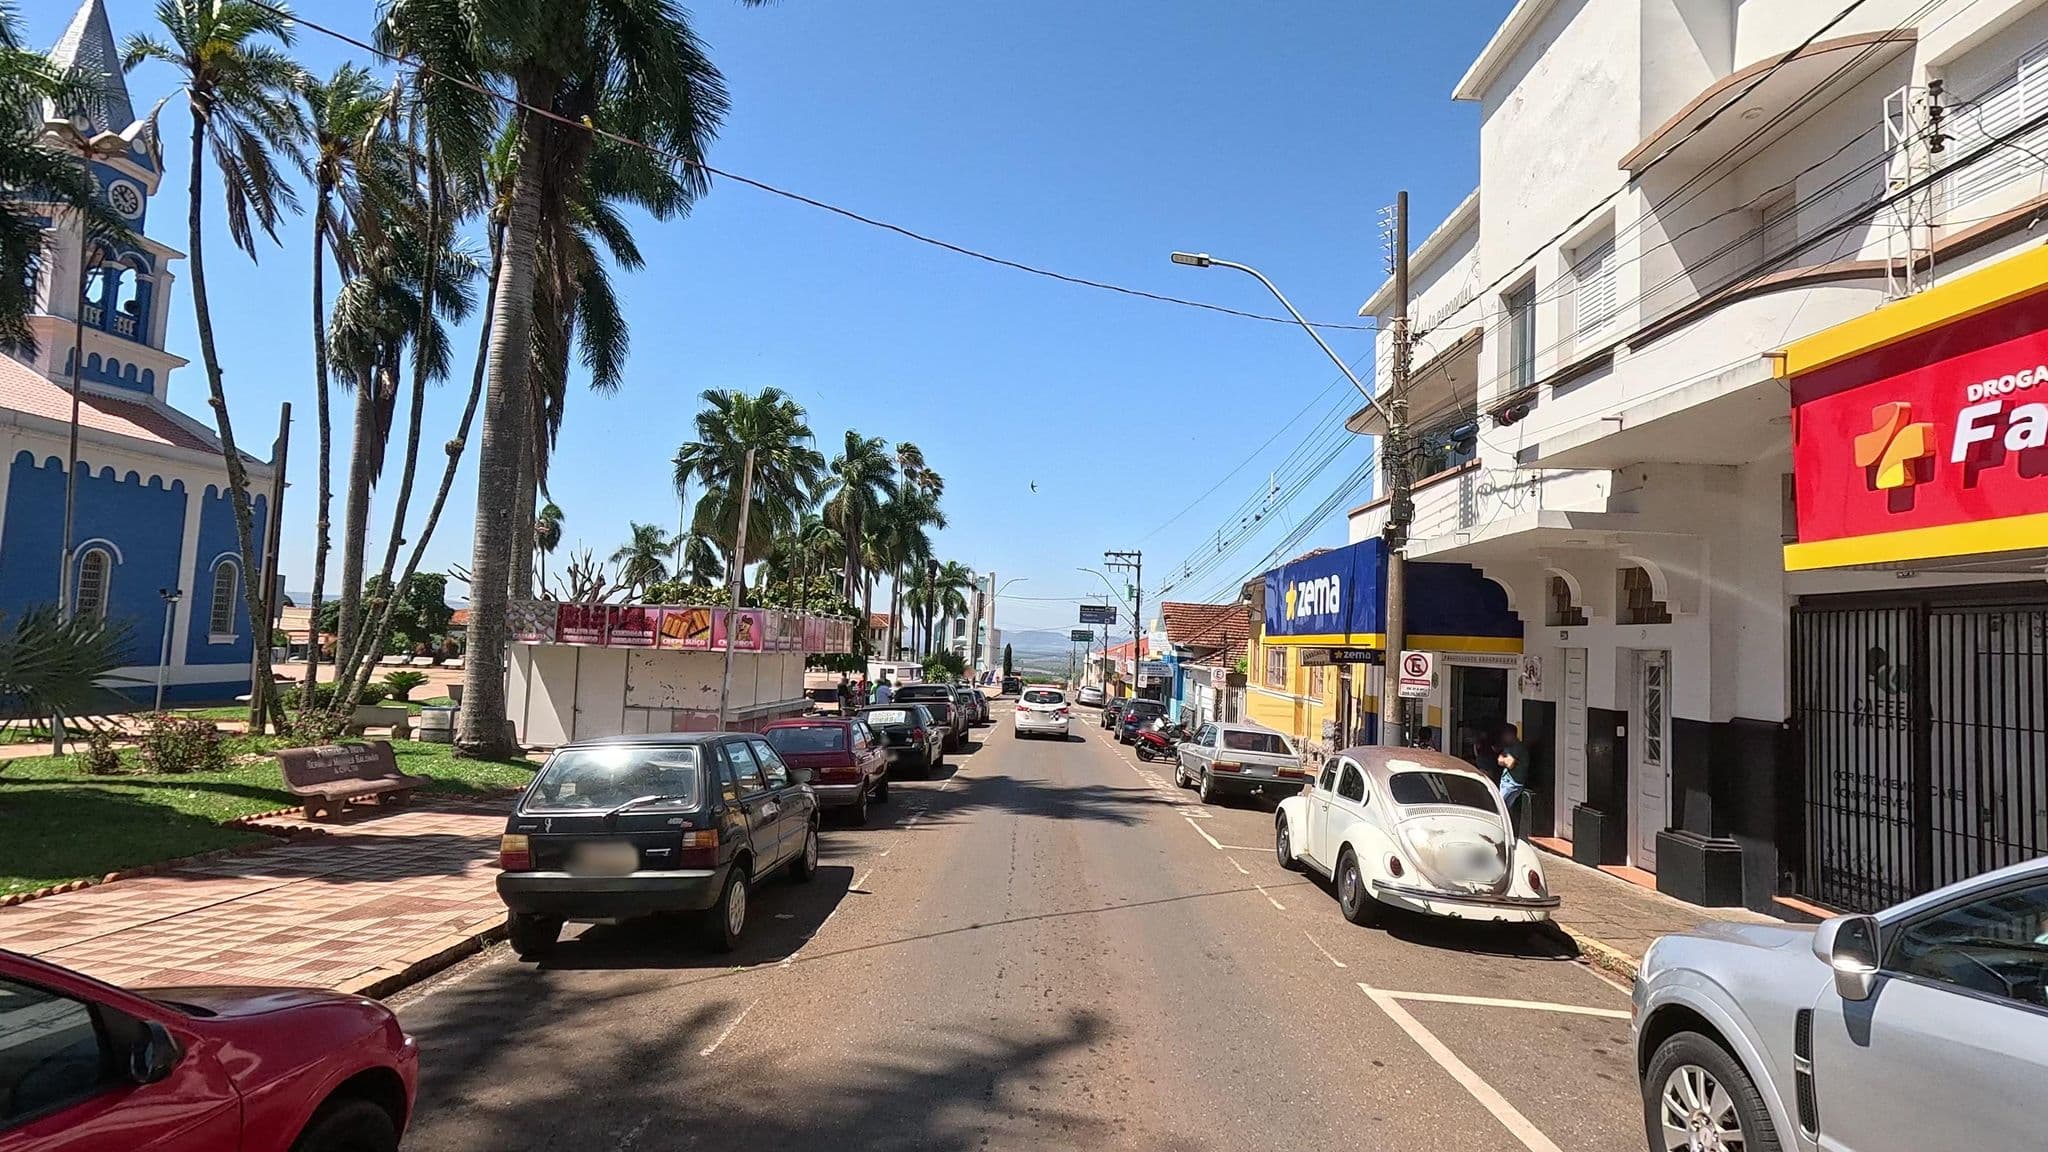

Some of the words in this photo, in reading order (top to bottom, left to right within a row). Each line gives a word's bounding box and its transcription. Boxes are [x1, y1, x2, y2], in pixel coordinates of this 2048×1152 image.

[1297, 574, 1341, 617] zema
[718, 639, 754, 647] CHRROS
[1343, 650, 1371, 660] zema
[1853, 697, 1907, 716] CAFEE
